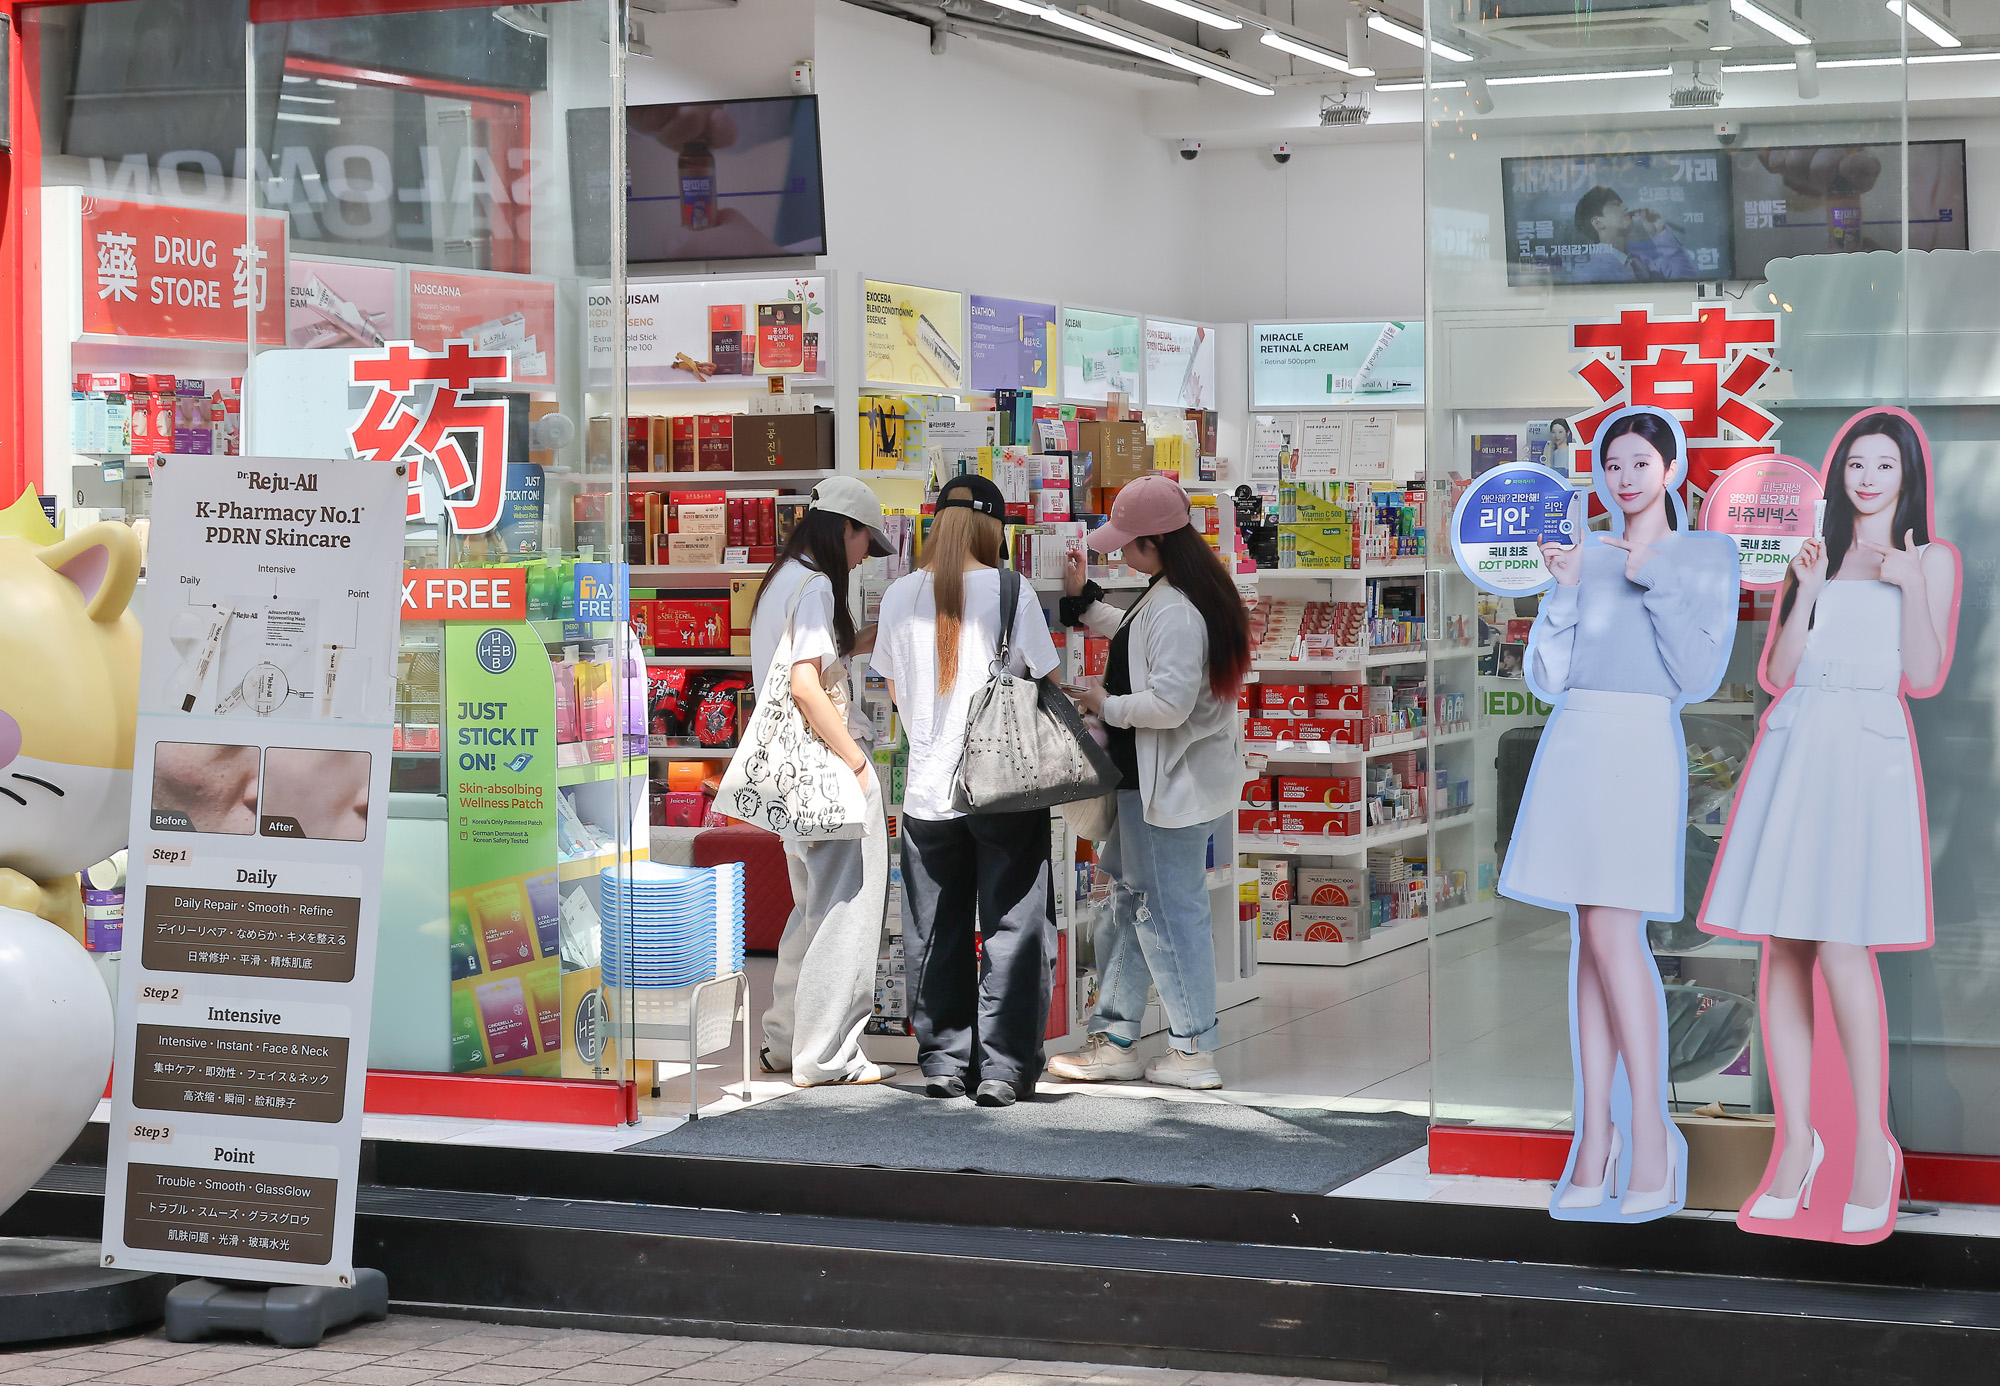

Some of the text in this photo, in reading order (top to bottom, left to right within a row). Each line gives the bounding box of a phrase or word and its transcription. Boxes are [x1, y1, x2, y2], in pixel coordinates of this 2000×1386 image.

[1512, 162, 1596, 193] 재채기
[1671, 159, 1718, 182] 가래
[1744, 200, 1786, 214] 밤에도
[1517, 221, 1554, 239] 콧물
[154, 235, 217, 268] DRUG
[97, 230, 138, 302] 藥
[232, 244, 267, 312] 药
[150, 276, 221, 309] STORE
[414, 284, 461, 297] NOSCARNA
[867, 291, 891, 304] EXOCERA
[588, 294, 659, 306] DONUISAM
[867, 304, 913, 318] BLEND CONDITIONING
[972, 306, 996, 317] EVATHION
[588, 319, 608, 328] RED
[867, 315, 886, 325] ESSENCE
[1065, 319, 1081, 328] ACLEAN
[639, 333, 657, 341] Stick
[1260, 333, 1304, 342] MIRACLE
[640, 344, 653, 352] 100
[1260, 343, 1349, 354] RETINAL A CREAM
[1287, 358, 1316, 366] 500ppm
[349, 342, 509, 532] 药
[766, 428, 776, 466] 공진단
[237, 471, 318, 493] Dr. Reju-All
[525, 477, 540, 487] JUST
[1763, 482, 1801, 493] 피부재생
[528, 490, 540, 500] ON!
[1512, 493, 1540, 503] 리안해!
[1730, 493, 1800, 505] 영양이 필요할 때
[196, 501, 316, 527] K-Pharmacy
[1544, 502, 1563, 512] 리안
[1480, 507, 1530, 535] 리안
[1728, 506, 1798, 523] 리쥬비넥스
[206, 527, 351, 548] PDRN Skincare
[1740, 539, 1780, 550] 국내 최초
[1489, 547, 1528, 557] 국내 최초
[1756, 553, 1790, 563] PDRN
[258, 564, 296, 574] Intensive
[1479, 560, 1538, 570] DOT PDRN
[180, 575, 200, 587] Daily
[348, 589, 369, 599] Point
[426, 579, 511, 609] FREE
[580, 600, 622, 617] FREE
[457, 703, 507, 720] JUST
[458, 728, 538, 746] STICK IT
[459, 753, 495, 771] ON!
[459, 783, 543, 797] Skin-absolbing
[459, 798, 543, 810] Wellness Patch
[155, 815, 187, 826] Before
[268, 821, 294, 832] After
[152, 848, 187, 863] Step 1
[236, 869, 277, 888] Daily
[174, 897, 334, 917] Daily Repair Smooth Refine
[157, 923, 346, 946] デイリーリペア なめらか キメを整える
[486, 929, 514, 940] PARTY PATCH
[188, 951, 230, 964] 日常修护
[240, 954, 260, 966] 平滑
[143, 987, 179, 1001] Step 2
[207, 1007, 281, 1025] Intensive
[540, 1013, 553, 1021] PARTY
[488, 1019, 513, 1029] CINDERELLA
[488, 1021, 522, 1034] BALANCE PATCH
[158, 1035, 329, 1057] Intensive Instant Face & Neck
[153, 1062, 196, 1075] 集中ケア
[205, 1066, 236, 1079] 即効性
[184, 1090, 296, 1109] 高浓缩 瞬间 脸和脖子
[134, 1125, 169, 1140] Step 3
[214, 1147, 255, 1164] Point
[156, 1175, 311, 1198] Trouble Smooth GlassGlow
[149, 1202, 310, 1226] トラブル スムーズ グラスグロウ
[167, 1229, 289, 1251] 肌肤问题 光滑 玻璃水光
